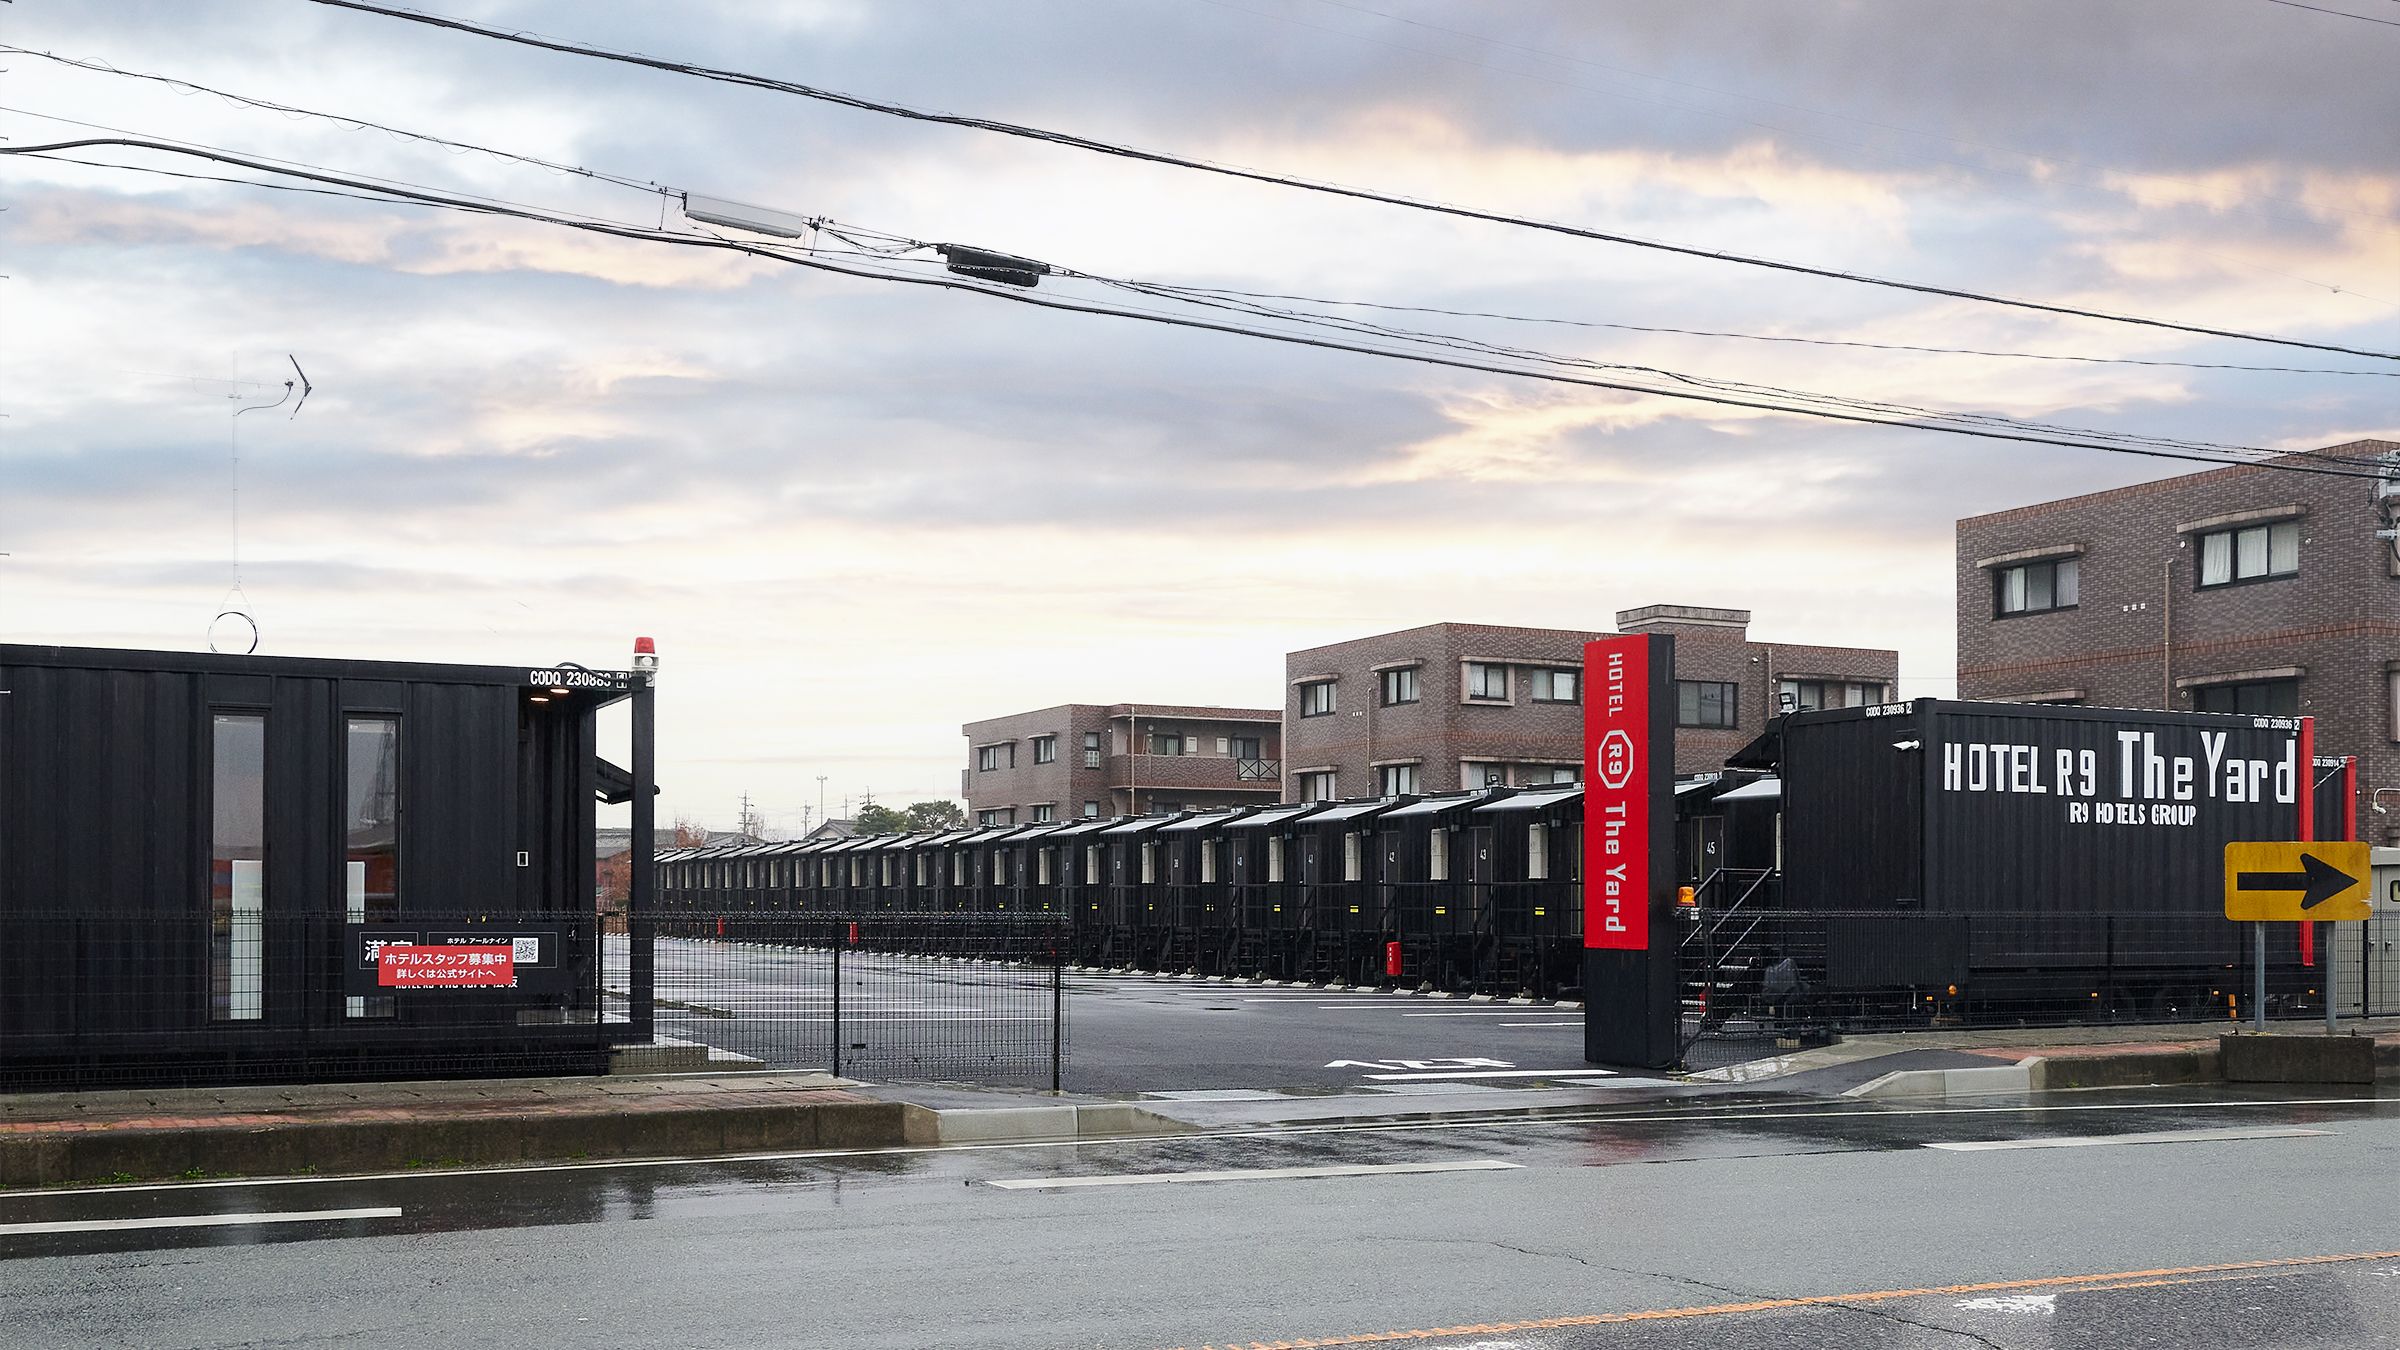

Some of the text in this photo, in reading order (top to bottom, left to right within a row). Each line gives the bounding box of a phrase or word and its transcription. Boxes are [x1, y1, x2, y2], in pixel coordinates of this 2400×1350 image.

[530, 670, 562, 686] CODQ
[2253, 718, 2268, 728] CODQ
[1944, 730, 2296, 804] HOTEL R9 The Yard
[1605, 653, 1626, 931] HOTEL R9 The Yard
[2070, 802, 2197, 826] R9 HOTELS GROUP
[1706, 841, 1716, 854] 45
[446, 937, 508, 945] ホテル アールナイン
[384, 953, 507, 966] ホテルスタッフ募集中
[396, 969, 496, 979] 詳しくは公式サイトへ
